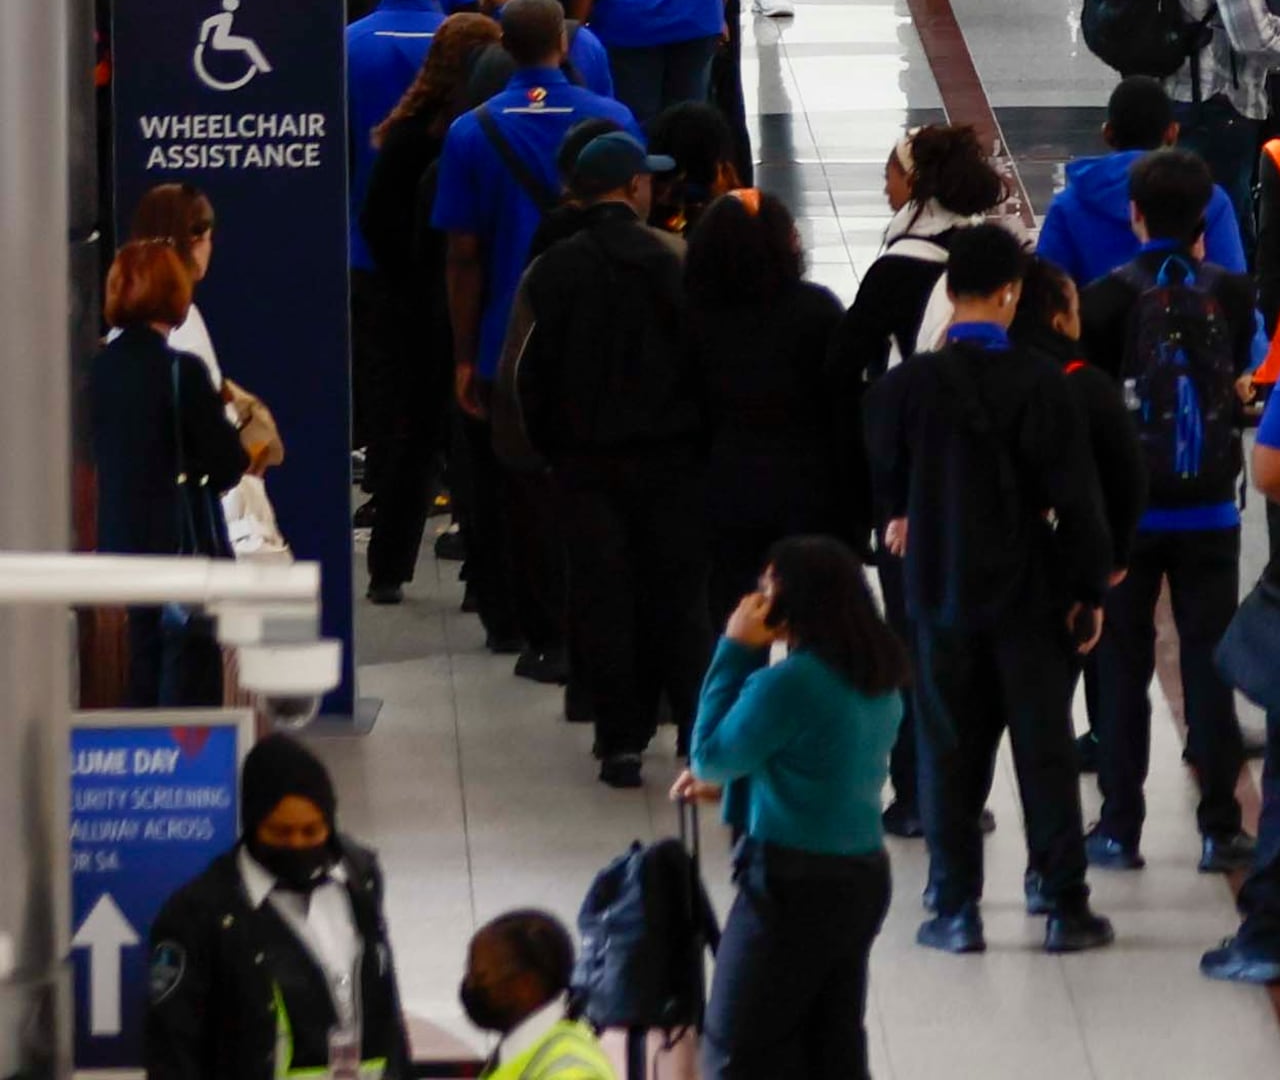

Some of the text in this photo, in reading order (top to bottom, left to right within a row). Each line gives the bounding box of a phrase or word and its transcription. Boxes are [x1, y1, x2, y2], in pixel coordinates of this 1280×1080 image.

[139, 113, 326, 139] WHEELCHAIR
[146, 143, 321, 170] ASSISTANCE
[133, 747, 180, 776] DAY
[73, 784, 231, 810] URITY SCREENING
[143, 815, 215, 841] ACROSS
